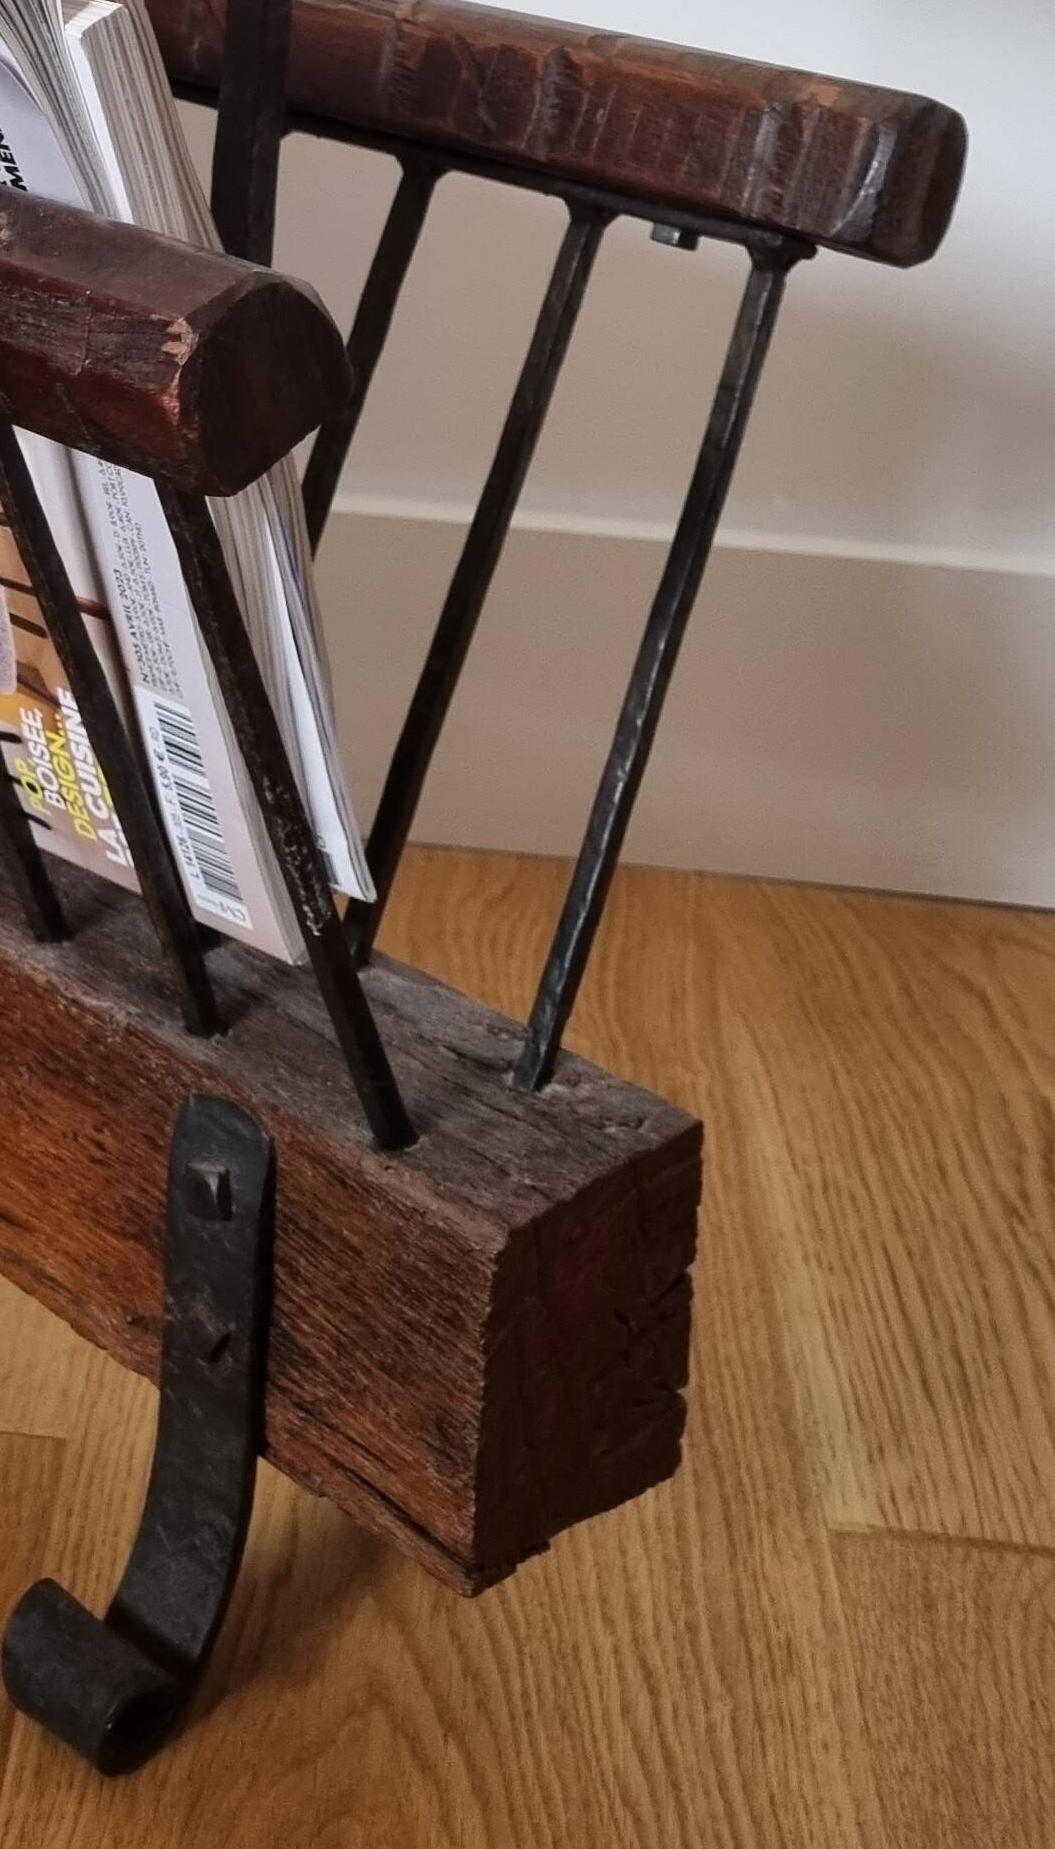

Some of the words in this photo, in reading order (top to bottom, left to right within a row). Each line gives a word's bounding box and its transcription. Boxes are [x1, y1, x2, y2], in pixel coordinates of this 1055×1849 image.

[113, 568, 129, 601] 2023
[122, 604, 139, 641] AVRIL
[57, 687, 110, 820] CUISINE
[97, 829, 129, 868] LA
